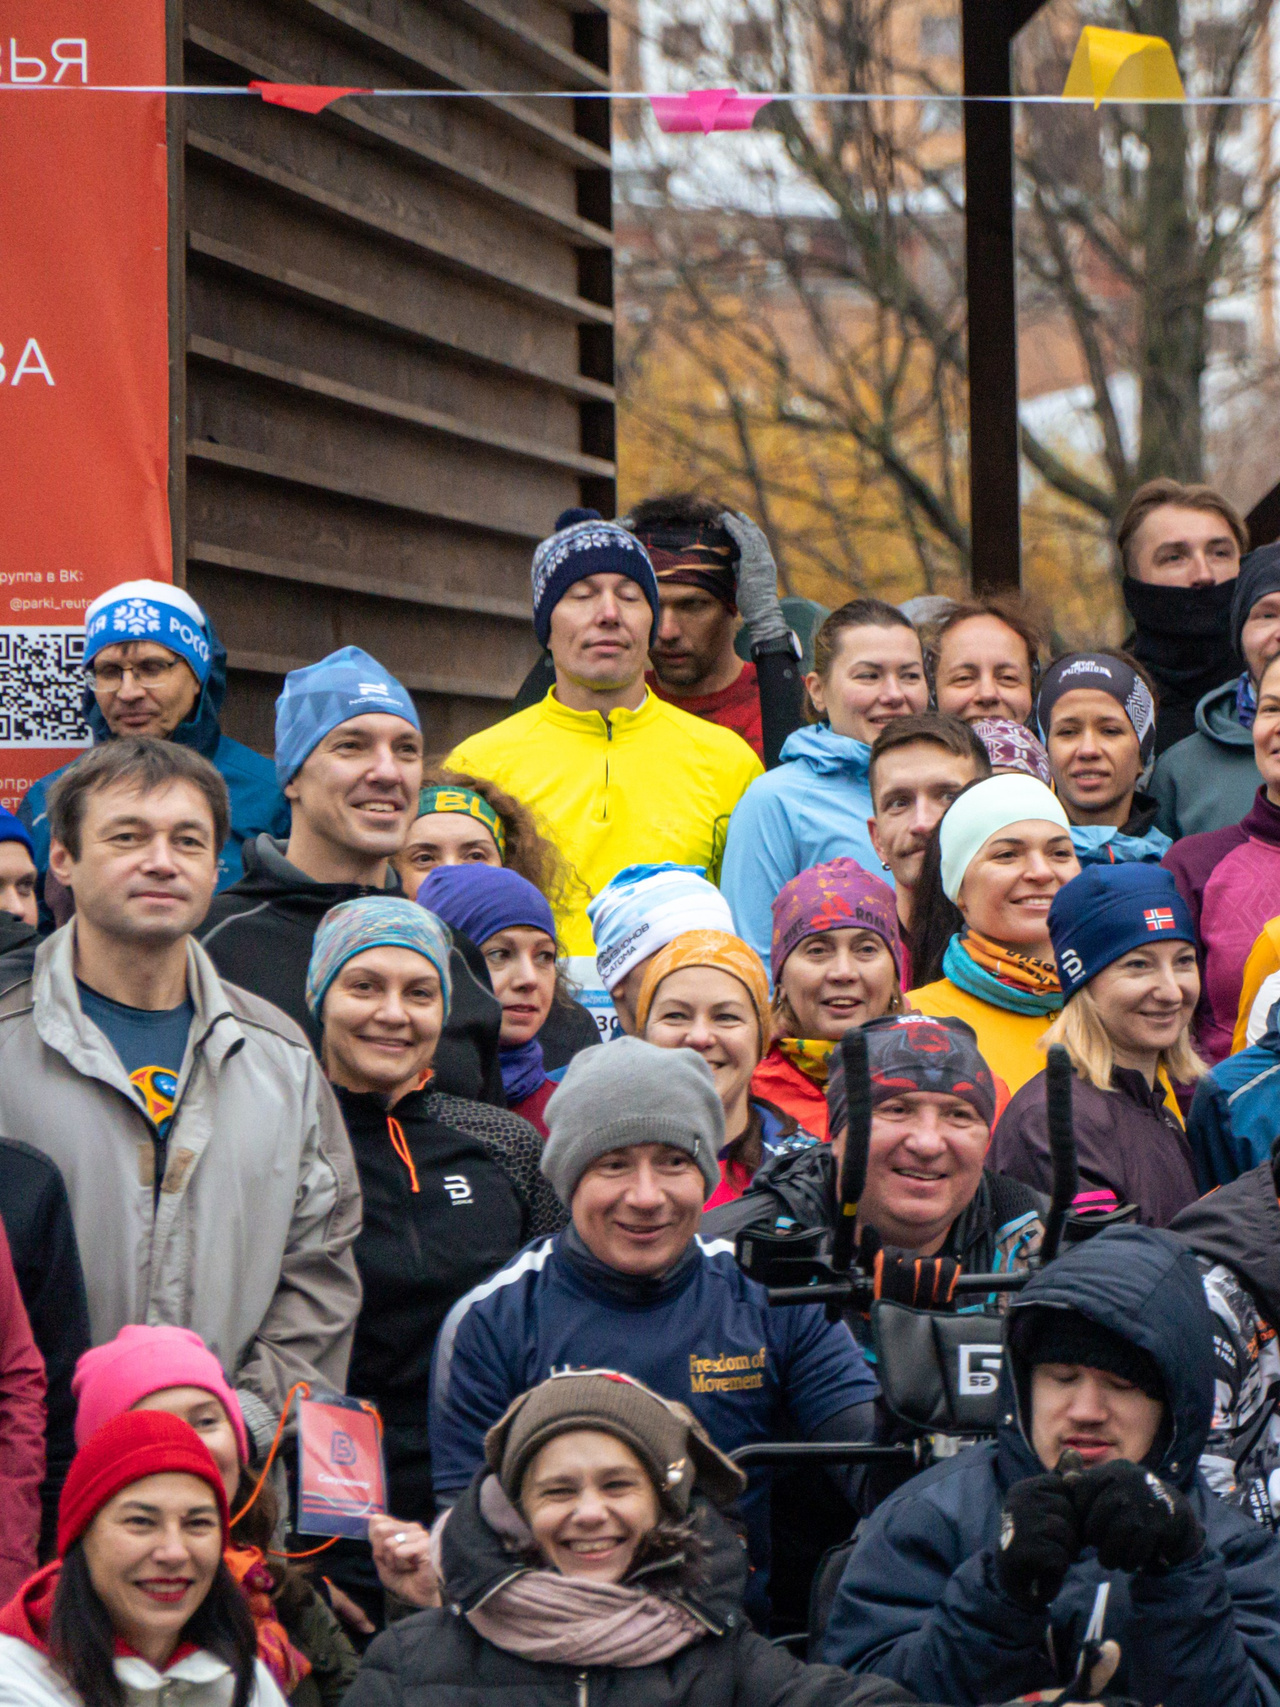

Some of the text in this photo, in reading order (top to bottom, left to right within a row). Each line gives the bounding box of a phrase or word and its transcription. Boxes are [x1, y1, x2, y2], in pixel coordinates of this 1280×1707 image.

[0, 38, 87, 83] ЬЯ
[0, 338, 55, 386] А
[46, 571, 56, 583] в
[59, 569, 84, 582] ВК:
[689, 1347, 766, 1373] Freedom of
[690, 1372, 763, 1393] Movement
[969, 1375, 991, 1387] 52
